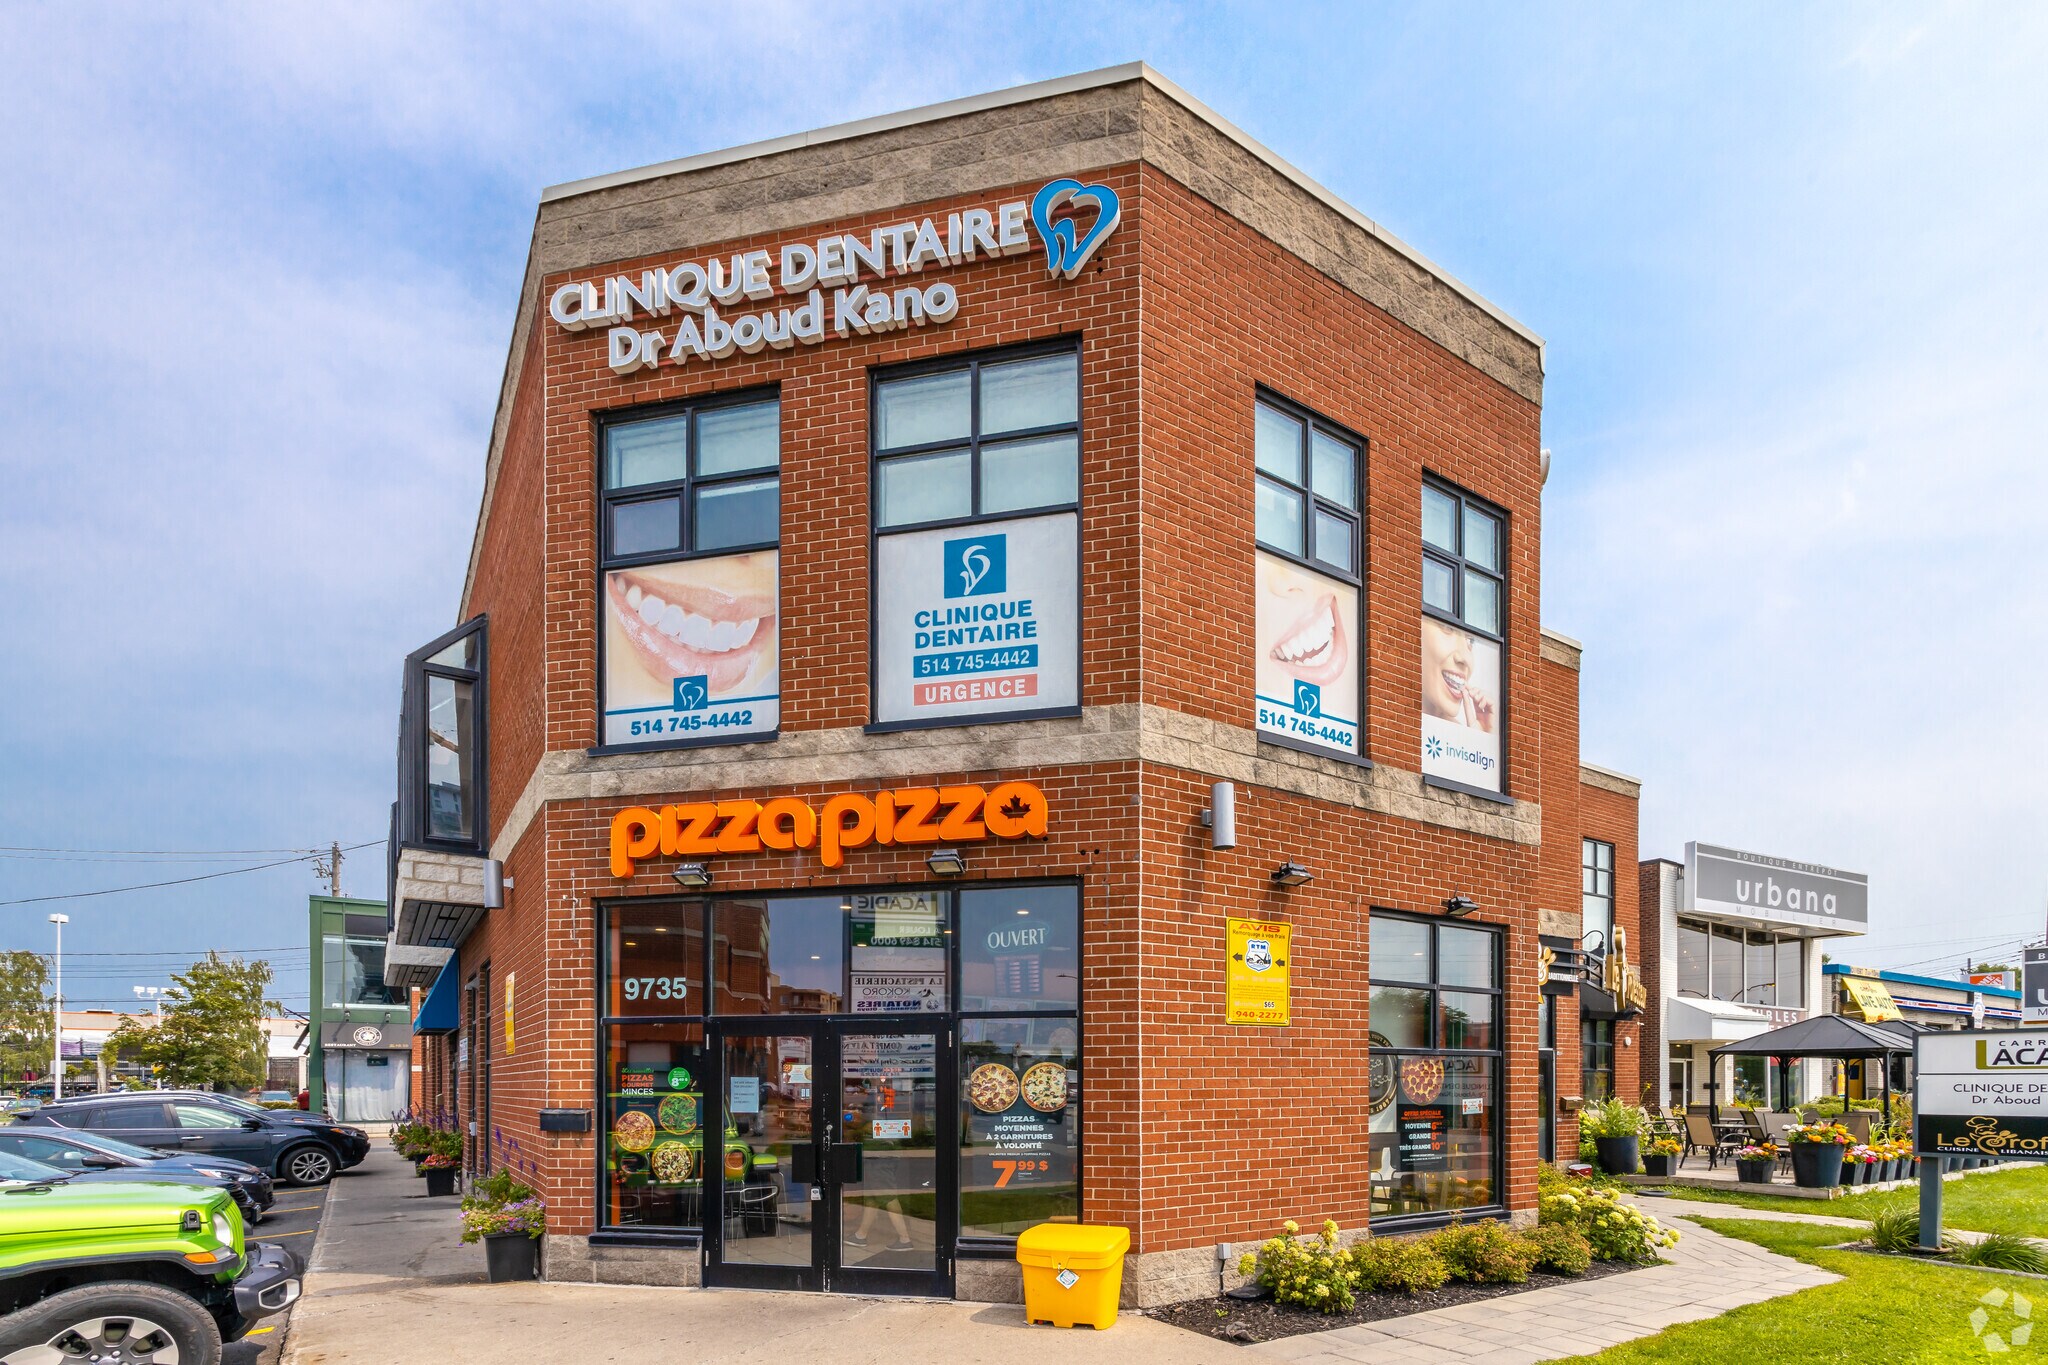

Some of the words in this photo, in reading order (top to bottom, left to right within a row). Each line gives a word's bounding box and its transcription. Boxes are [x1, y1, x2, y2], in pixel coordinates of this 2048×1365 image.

[550, 250, 774, 332] CLINIQUE
[781, 201, 1031, 294] DENTAIRE
[608, 326, 665, 375] Dr
[670, 290, 825, 366] Aboud
[834, 283, 959, 339] Kano
[914, 600, 1032, 628] CLINIQUE
[915, 620, 1037, 649] DENTAIRE
[921, 657, 950, 674] 514
[955, 649, 1030, 671] 745-4442
[925, 678, 1026, 703] URGENCE
[630, 719, 663, 736] 514
[668, 710, 752, 732] 745-4442
[1259, 708, 1286, 729] 514
[1290, 717, 1353, 747] 745-4442
[1446, 742, 1495, 770] invisalign
[610, 797, 817, 879] pizza
[820, 781, 1049, 869] pizza
[1736, 852, 1787, 868] BOUTIQUE
[1736, 876, 1837, 915] urbana
[1736, 905, 1837, 926] MOBILIER
[1232, 929, 1261, 938] Remorquage
[1239, 922, 1280, 933] AVIS
[987, 927, 1046, 949] OUVERT
[624, 977, 687, 1001] 9735
[1235, 1010, 1283, 1019] 940-2277
[621, 1074, 654, 1082] PIZZAS
[621, 1088, 654, 1096] MINCES
[1953, 1083, 2024, 1094] CLINIQUE
[1972, 1095, 1988, 1104] Dr
[1993, 1095, 2041, 1105] Aboud
[994, 1124, 1044, 1132] MOYENNES
[1404, 1122, 1431, 1130] MOYENNE
[986, 1132, 993, 1140] À
[1408, 1132, 1431, 1140] GRANDE
[1937, 1133, 1971, 1147] Le
[995, 1141, 1002, 1149] À
[1398, 1143, 1412, 1151] TRÈS
[1411, 1143, 1431, 1151] GRANDE
